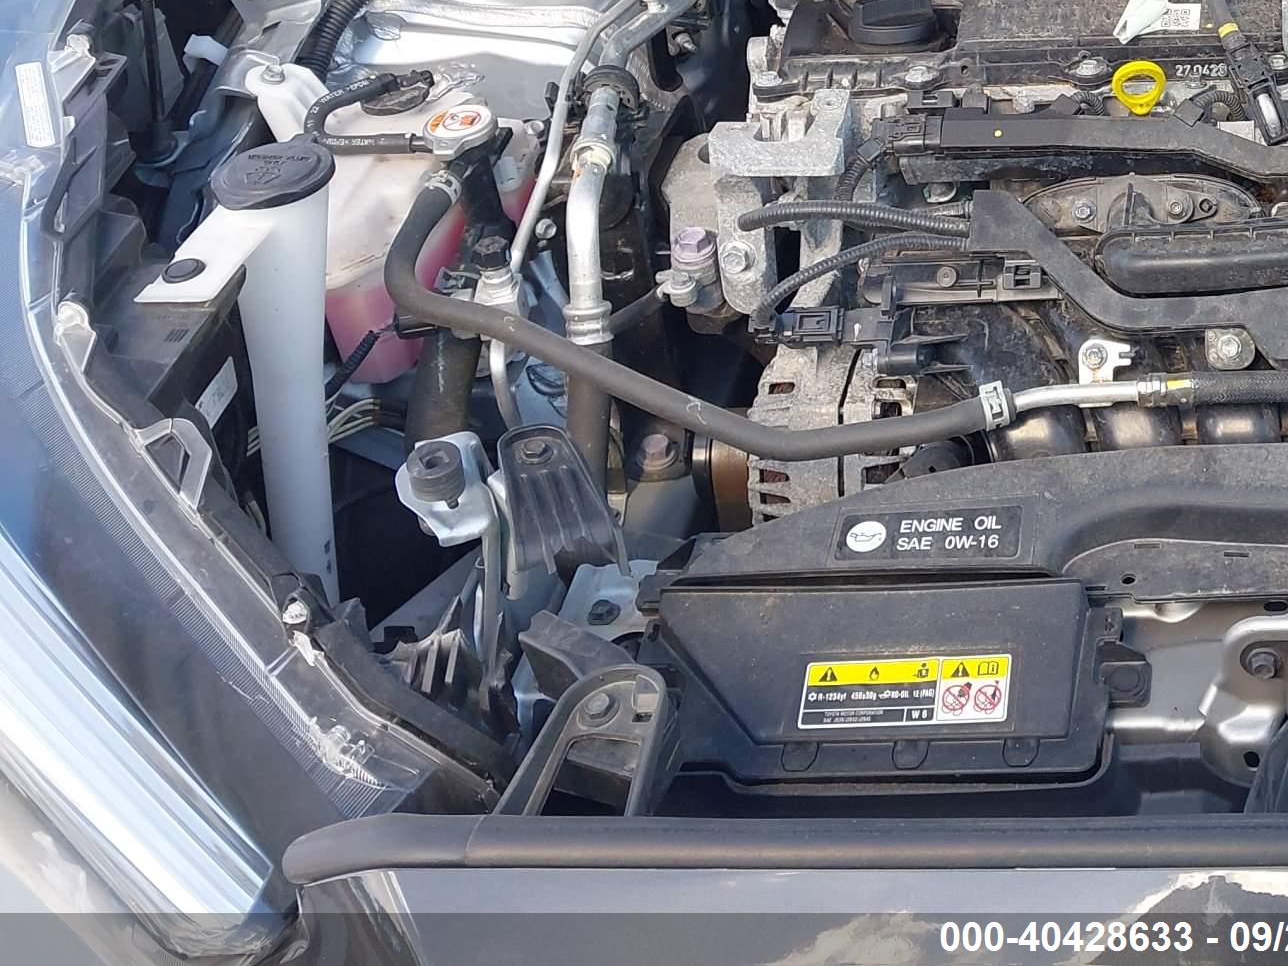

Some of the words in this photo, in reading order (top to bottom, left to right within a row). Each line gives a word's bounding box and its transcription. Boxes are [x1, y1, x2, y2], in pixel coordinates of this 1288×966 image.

[900, 517, 964, 533] ENGINE
[974, 515, 1002, 530] OIL
[896, 536, 933, 551] SAE
[944, 534, 1000, 549] 0W-16
[911, 709, 920, 719] W
